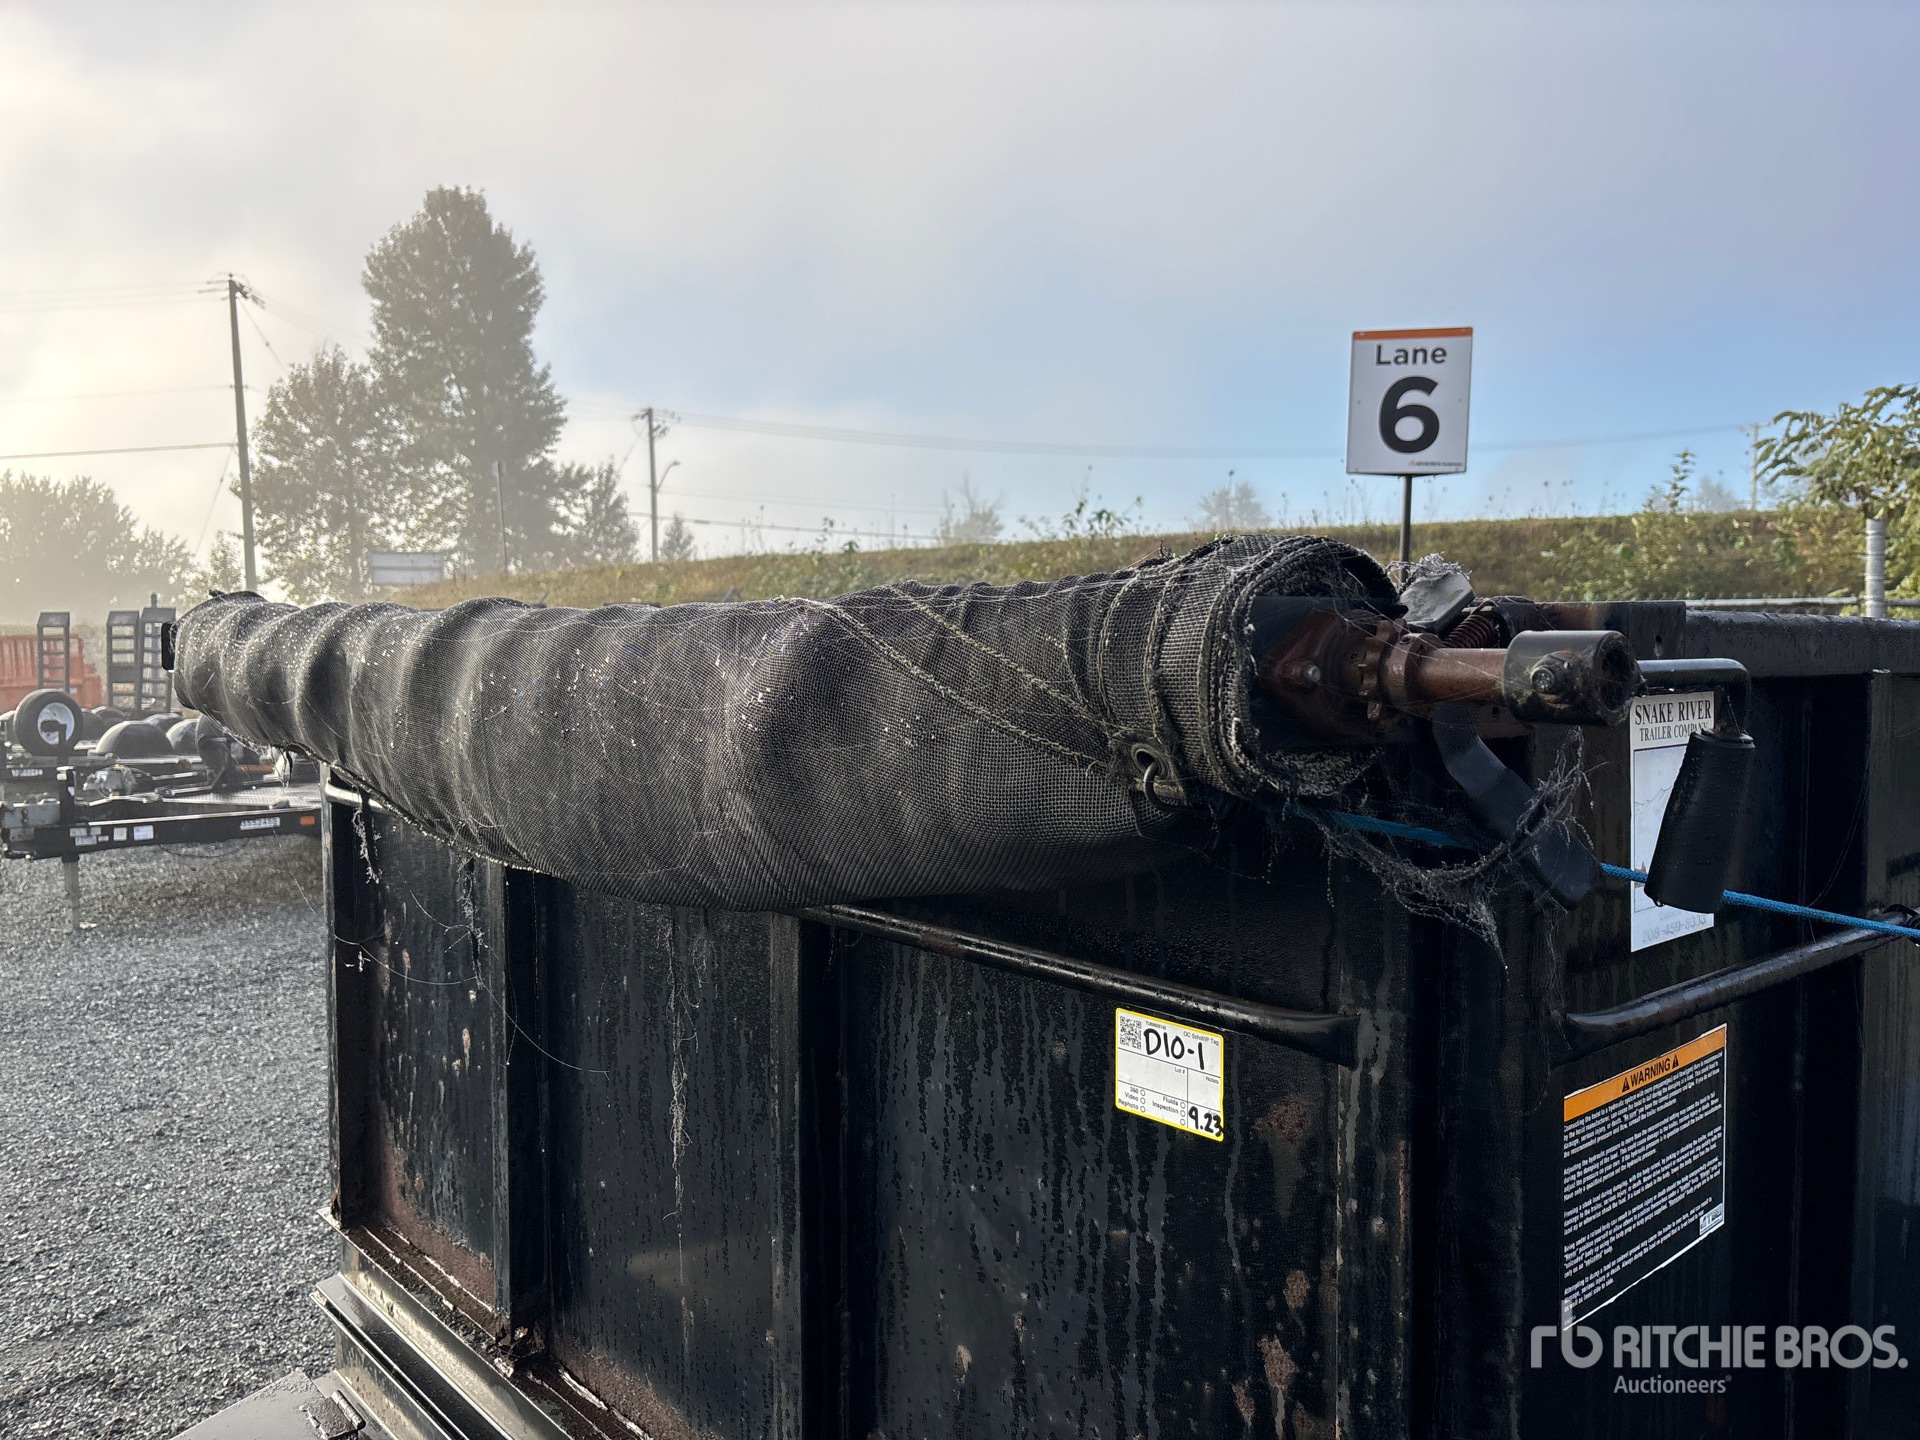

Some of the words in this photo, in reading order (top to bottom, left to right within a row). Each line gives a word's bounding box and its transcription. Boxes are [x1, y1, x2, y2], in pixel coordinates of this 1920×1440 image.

[1376, 344, 1447, 366] Lane
[1379, 376, 1440, 454] 6
[1635, 702, 1674, 726] SNAKE
[1678, 700, 1712, 722] RIVER
[1640, 726, 1672, 742] TRAILER
[1144, 1028, 1204, 1070] D10-1
[1210, 1038, 1220, 1046] Tag
[1205, 1076, 1219, 1084] Notes
[1630, 1058, 1671, 1086] WARNING
[1125, 1092, 1139, 1102] Video
[1162, 1096, 1178, 1106] Fluids
[1152, 1101, 1178, 1114] Inspection
[1188, 1106, 1223, 1137] 9.23
